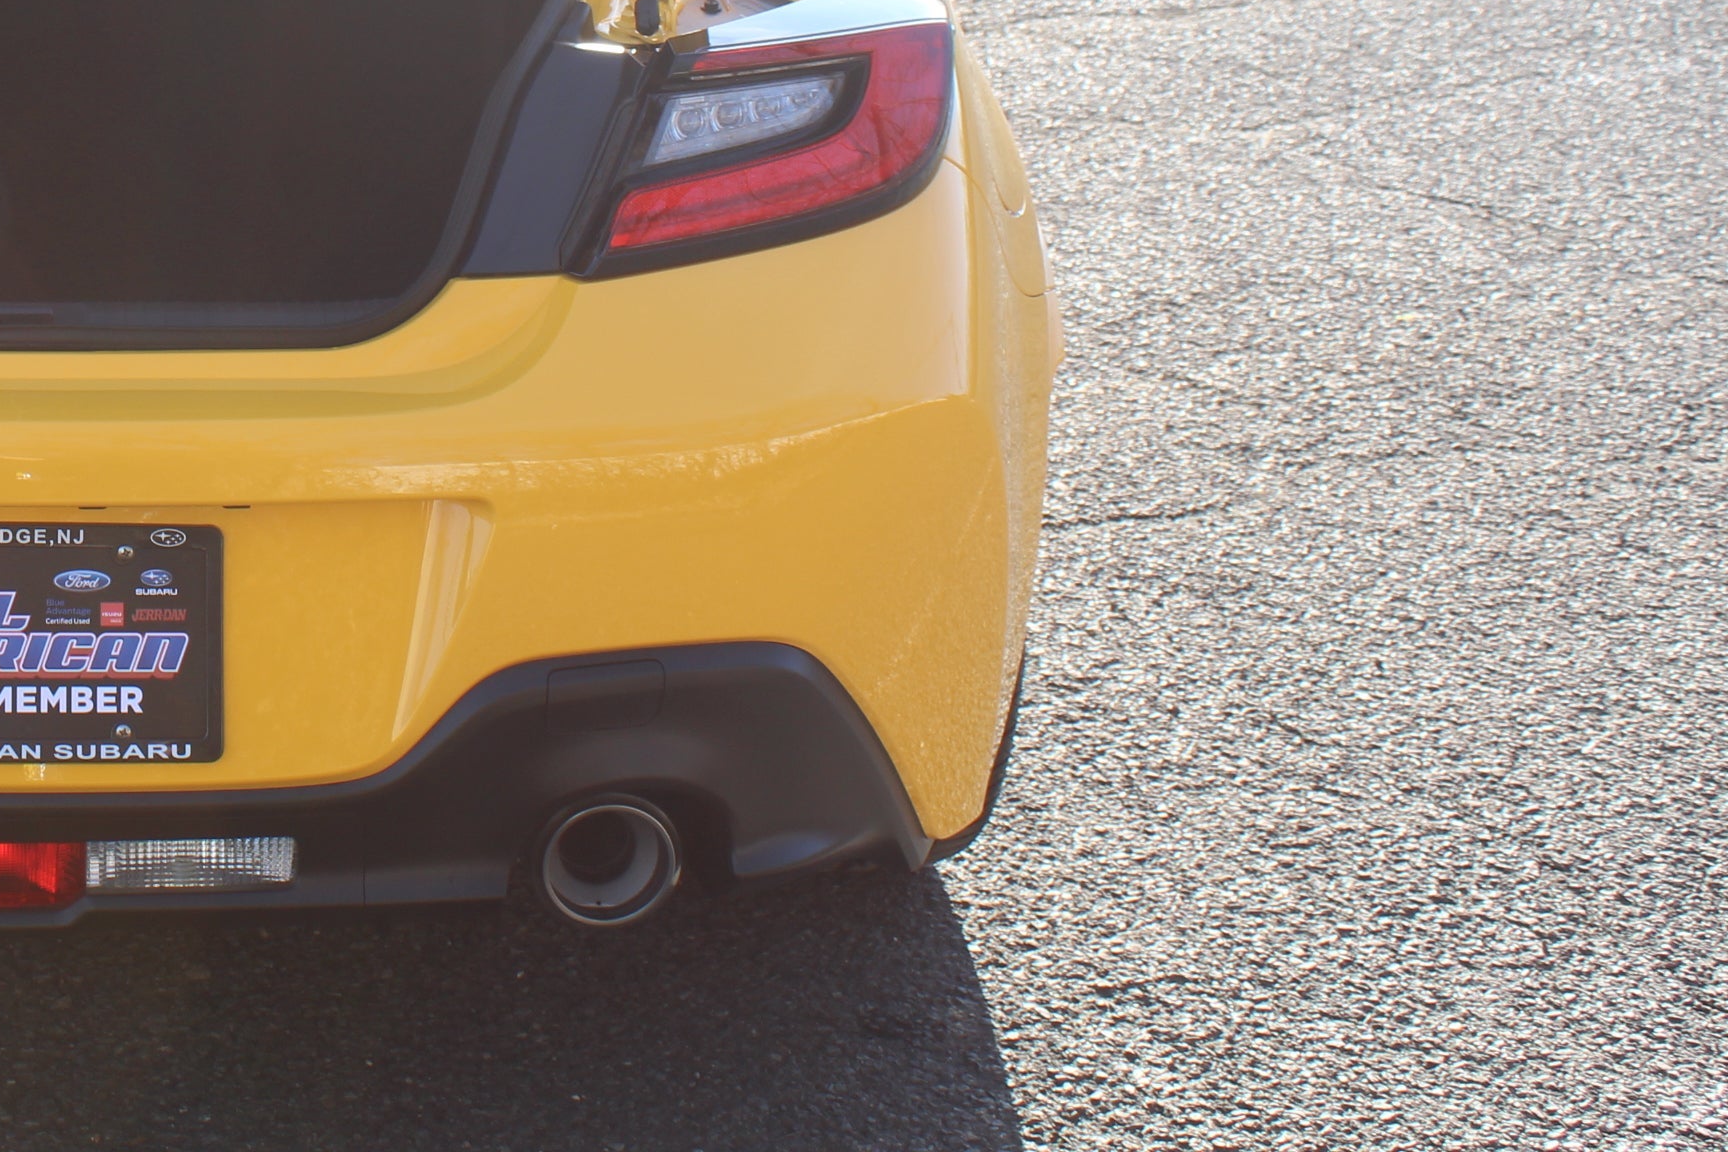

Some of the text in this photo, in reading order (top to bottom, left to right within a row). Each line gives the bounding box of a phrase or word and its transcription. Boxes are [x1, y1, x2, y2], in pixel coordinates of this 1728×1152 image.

[64, 573, 99, 589] Ford
[135, 587, 178, 596] SUBARU
[46, 599, 65, 607] Blue
[46, 607, 92, 617] Advantage
[45, 617, 91, 625] Certified Used
[53, 743, 192, 760] SUBARU
